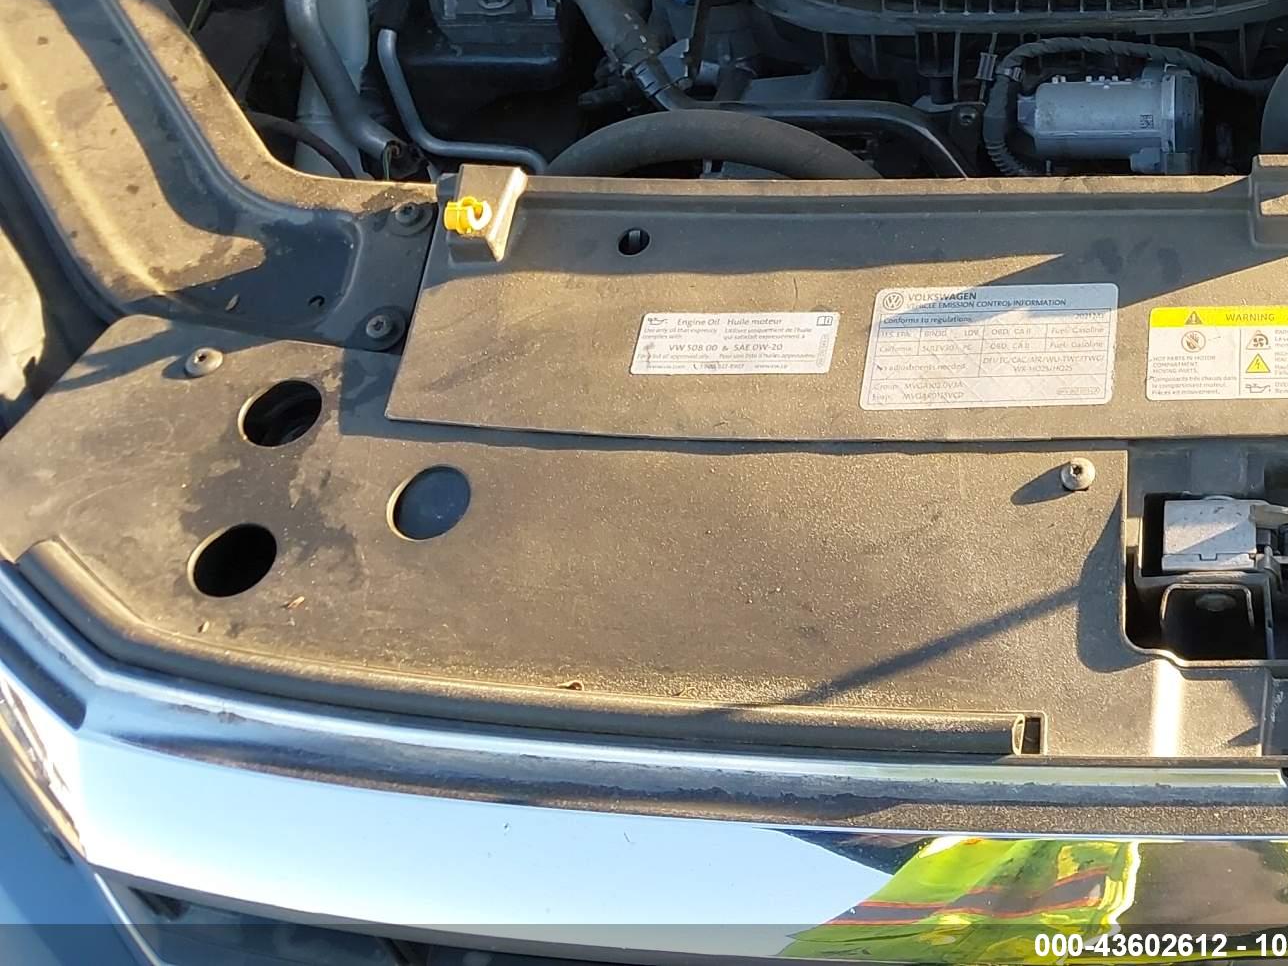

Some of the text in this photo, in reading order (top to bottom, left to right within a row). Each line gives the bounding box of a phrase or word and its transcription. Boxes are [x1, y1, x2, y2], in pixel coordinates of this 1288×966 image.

[908, 292, 977, 301] VOLKSWAGEN
[938, 301, 975, 309] EMISSION
[976, 300, 1011, 308] CONTROL
[1013, 299, 1066, 307] INFORMATION
[727, 318, 749, 326] Huile
[1225, 313, 1275, 322] WARNING
[677, 318, 720, 328] Engine Oil
[687, 344, 703, 352] 508
[734, 343, 751, 352] SAE
[752, 343, 783, 351] 0W-20
